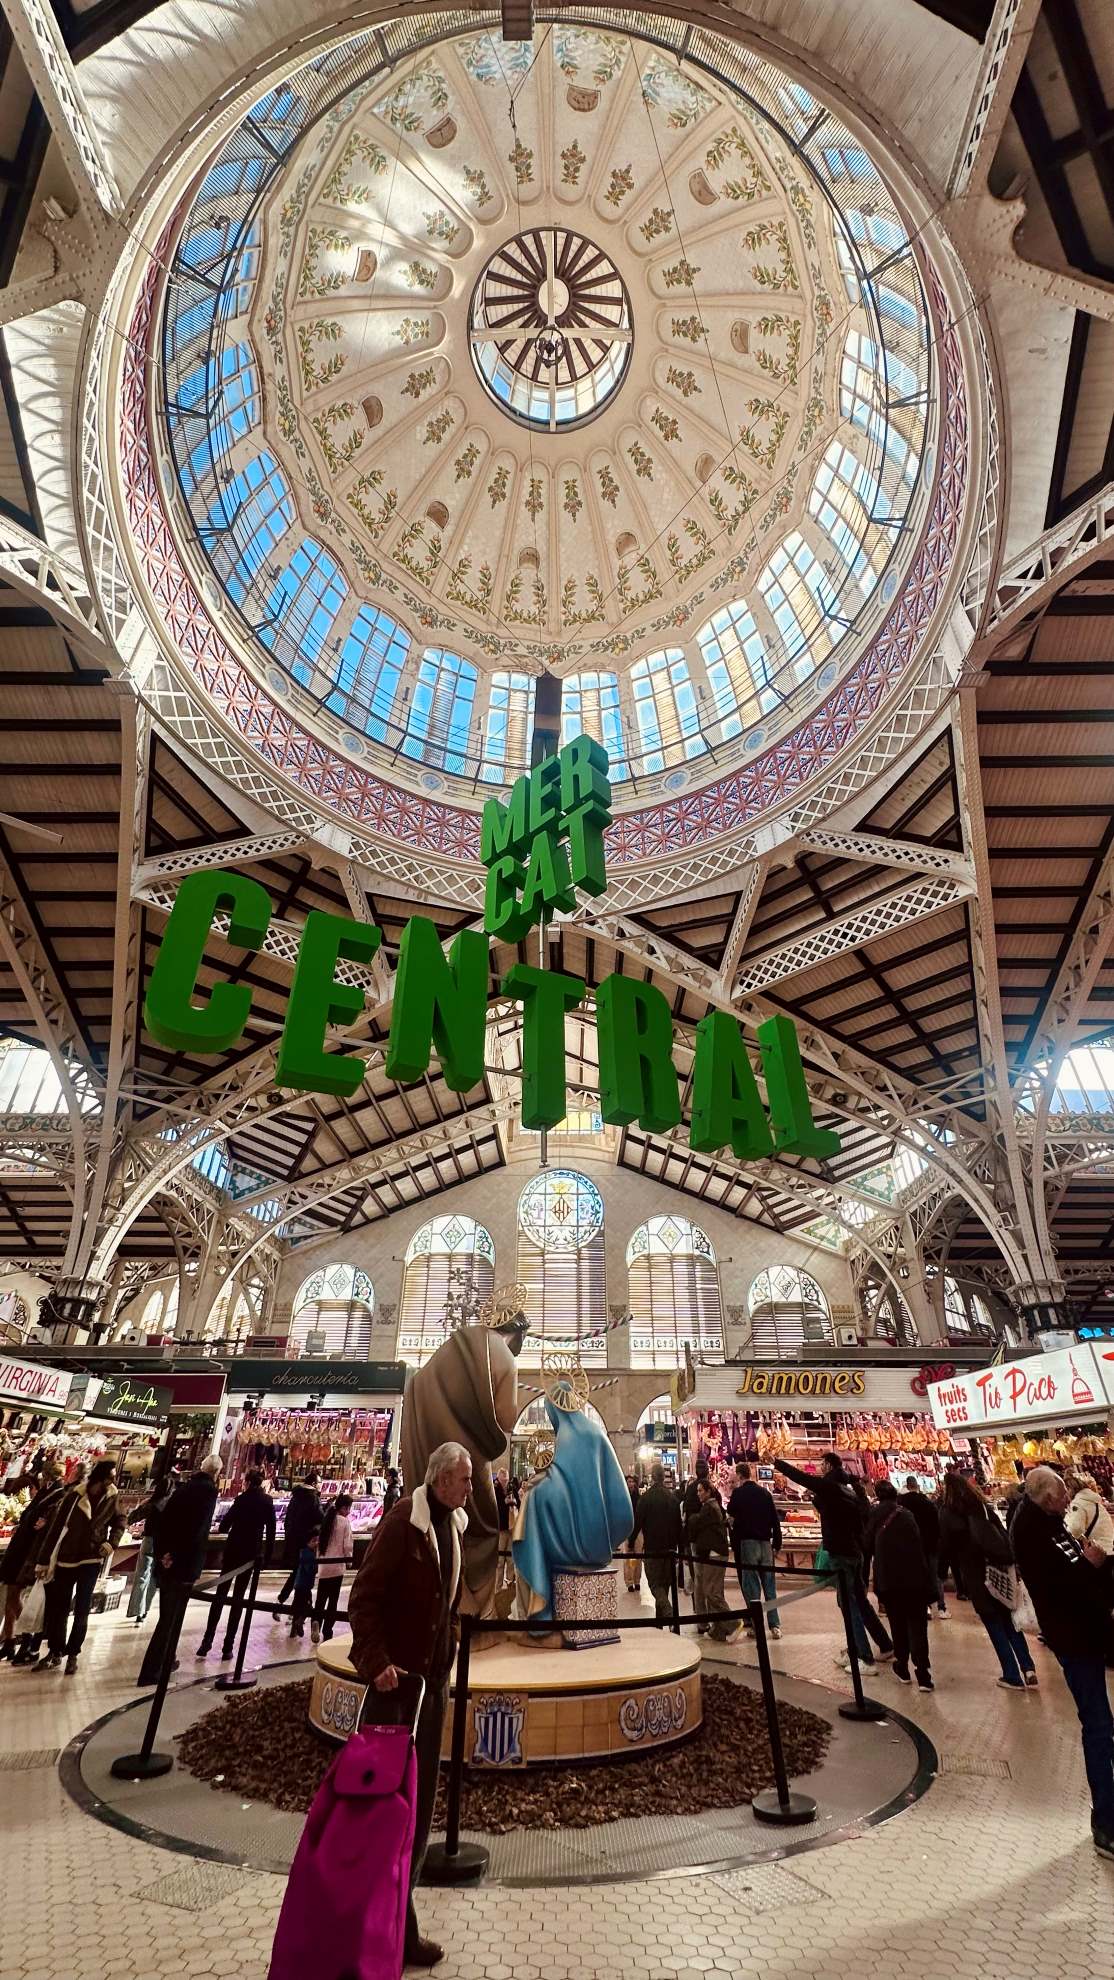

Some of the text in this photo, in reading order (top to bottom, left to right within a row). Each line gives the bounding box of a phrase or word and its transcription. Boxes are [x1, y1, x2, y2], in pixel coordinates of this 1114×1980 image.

[481, 734, 612, 868] MER
[484, 799, 613, 943] CAT
[145, 869, 842, 1161] CENTRAL
[736, 1366, 866, 1395] Jamones
[937, 1383, 968, 1407] fruits
[1004, 1366, 1058, 1413] Paco
[945, 1406, 968, 1424] secs
